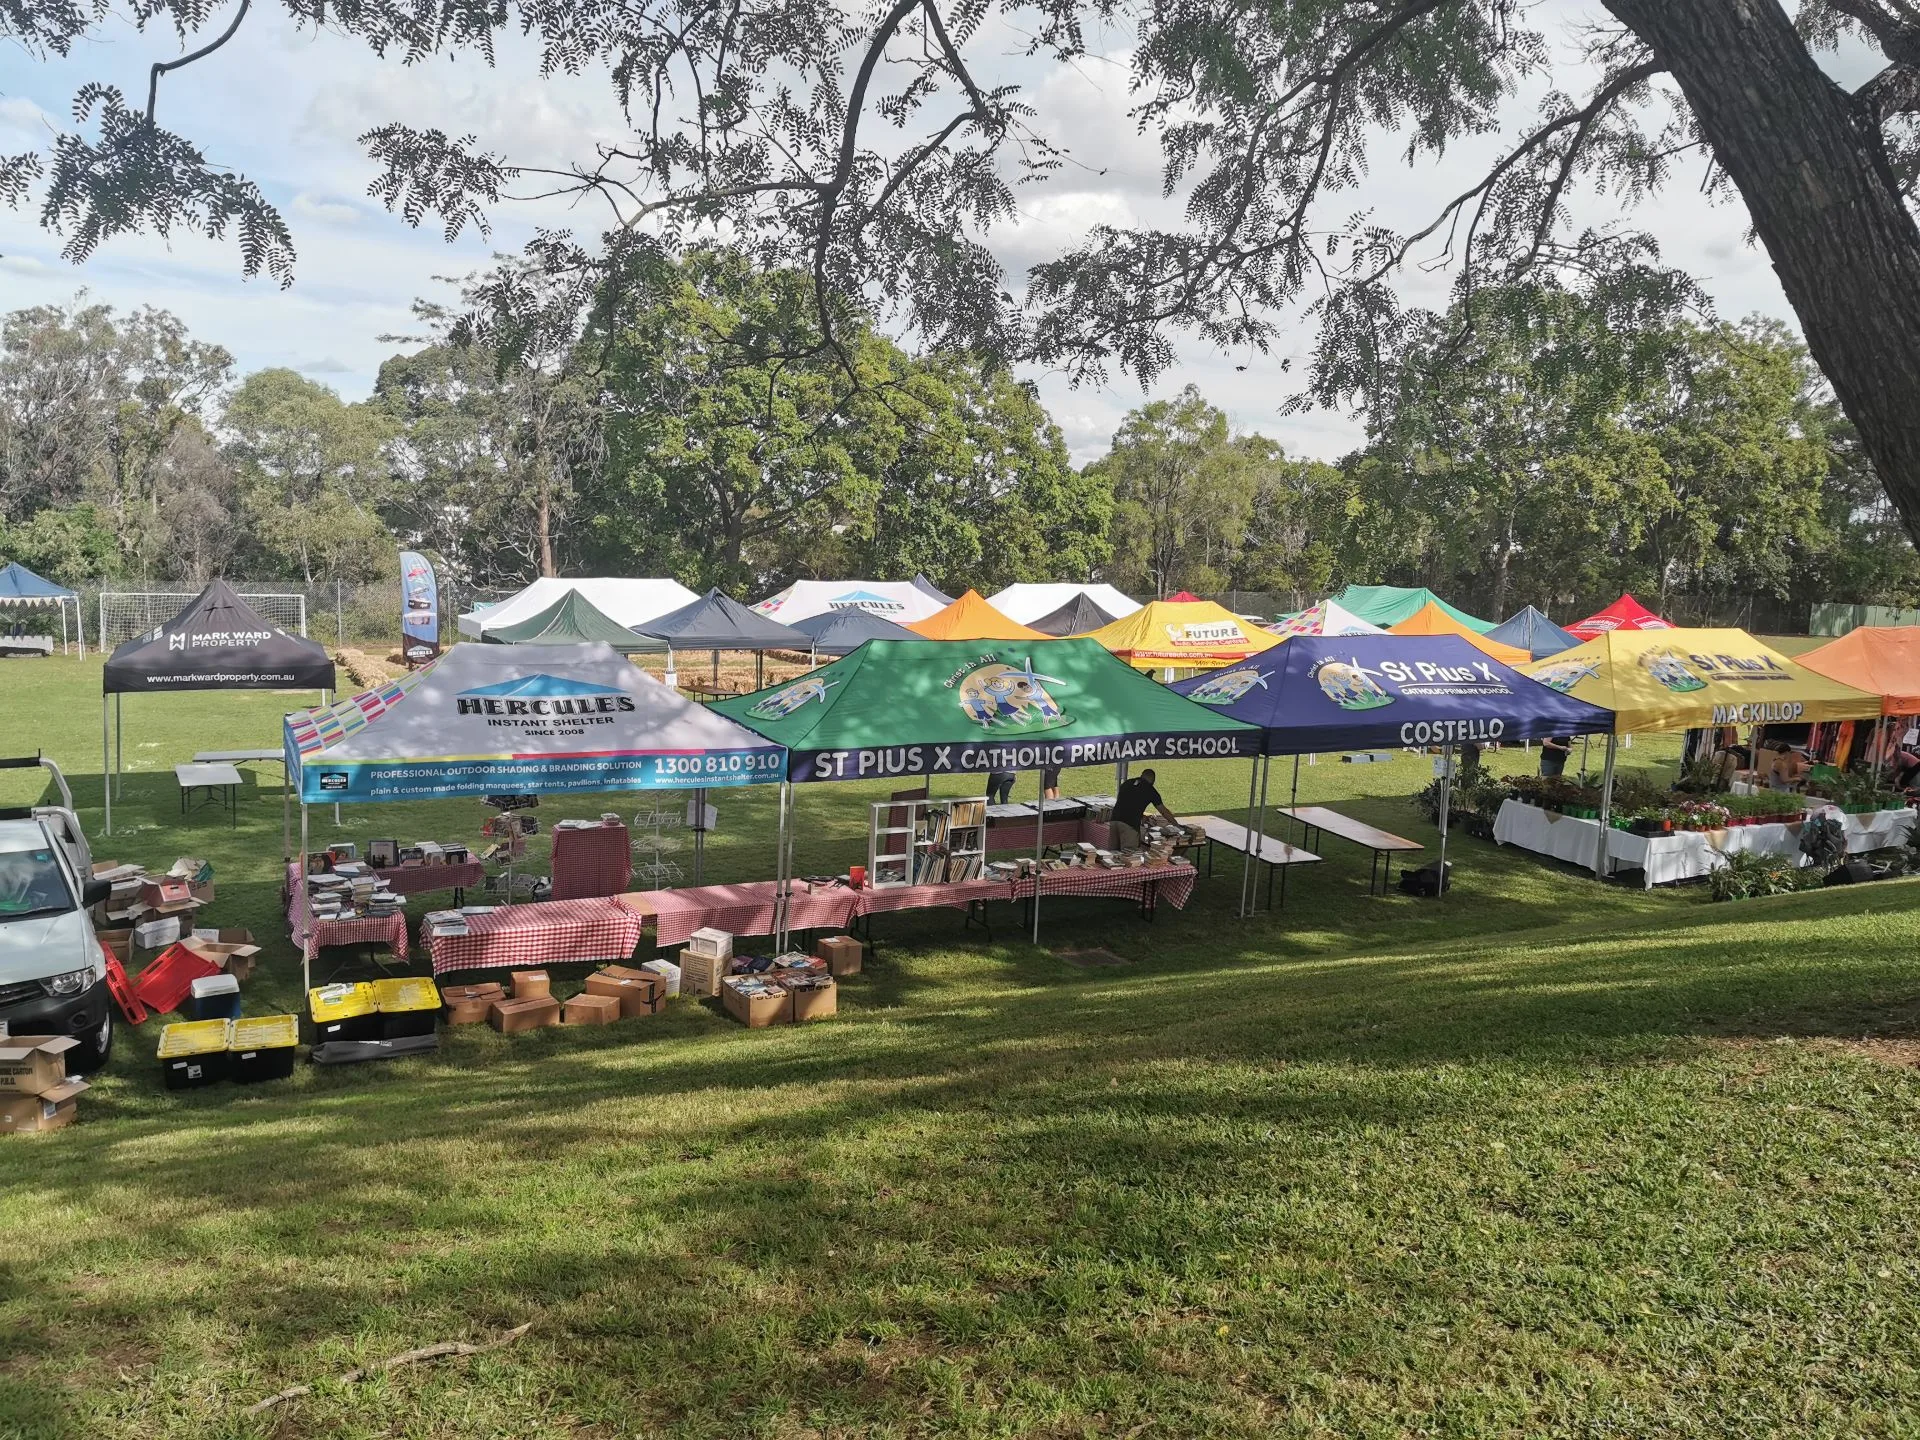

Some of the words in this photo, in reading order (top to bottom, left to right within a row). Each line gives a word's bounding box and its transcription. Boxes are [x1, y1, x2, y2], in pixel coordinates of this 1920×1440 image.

[192, 632, 230, 641] MARK
[233, 632, 272, 640] WARD
[1186, 628, 1238, 638] FUTURE
[192, 639, 260, 648] PROPERTY
[943, 668, 966, 689] Christ
[964, 662, 977, 670] in
[980, 654, 997, 664] All
[1379, 660, 1418, 682] St
[1414, 662, 1478, 682] Pius
[1472, 662, 1502, 682] X
[1689, 654, 1720, 670] St
[1714, 654, 1765, 671] Pius
[1757, 654, 1784, 671] X
[147, 672, 295, 682] www.markwardproperty.com.au
[456, 696, 636, 716] HERCULES
[1712, 702, 1803, 725] MACKILLOP
[553, 716, 615, 726] SHELTER
[558, 728, 584, 736] 2008
[1400, 718, 1504, 744] COSTELLO
[654, 758, 702, 774] 1300
[706, 756, 741, 772] 810
[745, 754, 780, 771] 910
[816, 752, 849, 778] ST
[858, 746, 924, 776] PIUS
[934, 746, 952, 770] X
[960, 746, 1065, 769] CATHOLIC
[1070, 738, 1160, 763] PRIMARY
[1165, 736, 1240, 756] SCHOOL
[370, 768, 446, 779] PROFESSIONAL
[446, 764, 496, 777] OUTDOOR
[497, 765, 539, 774] SHADING
[550, 763, 596, 773] BRANDING
[596, 761, 642, 770] SOLUTION
[654, 772, 779, 784] www.herculesinstantshelter.com.au
[370, 788, 391, 796] plain
[392, 786, 400, 794] &
[401, 786, 432, 794] custom
[433, 784, 456, 792] made
[456, 782, 484, 792] folding
[486, 782, 526, 790] marquees,
[528, 780, 543, 788] star
[544, 780, 567, 788] tents,
[568, 778, 603, 788] pavilions,
[604, 777, 642, 785] inflatables
